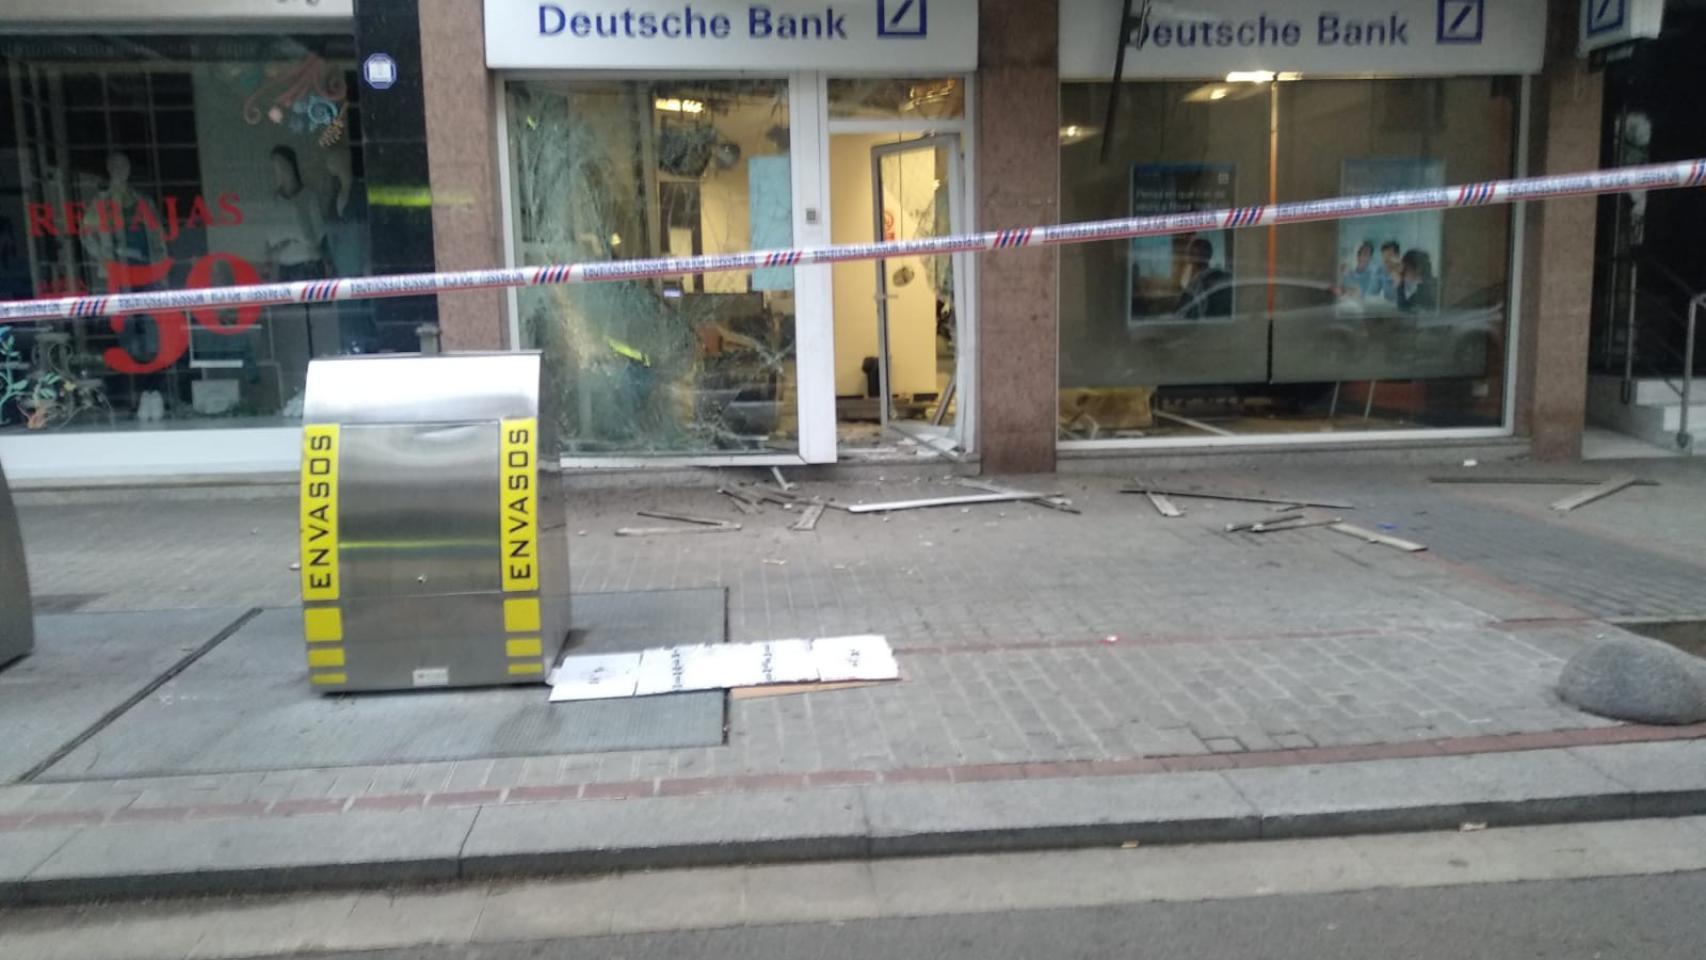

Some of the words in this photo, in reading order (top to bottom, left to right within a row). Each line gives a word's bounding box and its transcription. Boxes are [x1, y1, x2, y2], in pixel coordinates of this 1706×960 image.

[538, 4, 731, 38] Deutsche
[749, 6, 848, 39] Bank
[1317, 11, 1408, 47] Bank
[27, 193, 244, 241] REBAJAS
[103, 252, 262, 374] 50
[309, 434, 331, 589] ENVASOS
[508, 429, 531, 580] ENVASOS
